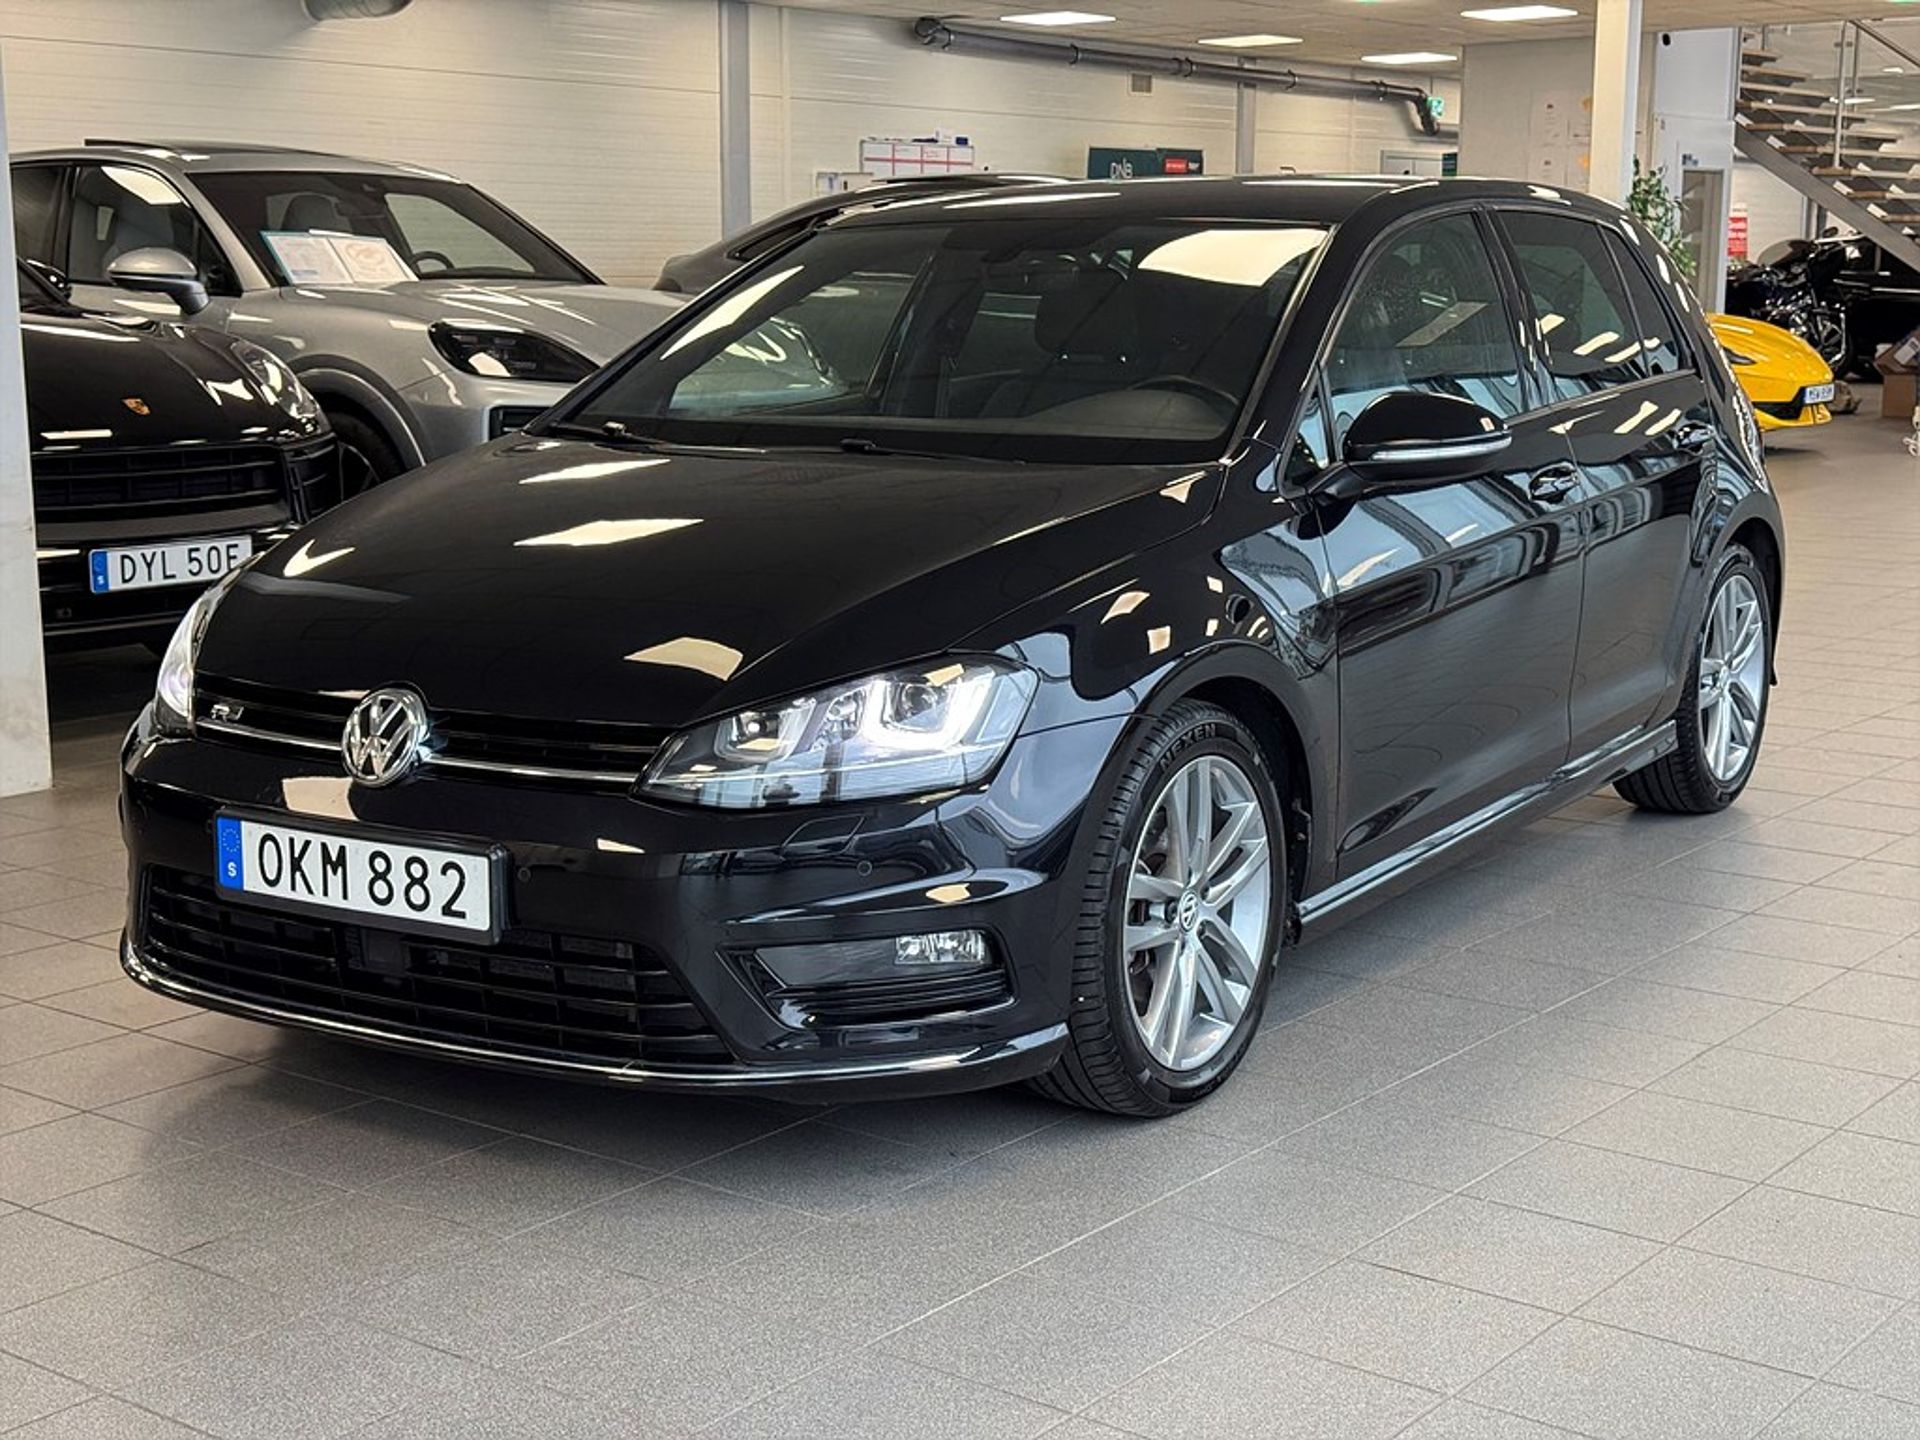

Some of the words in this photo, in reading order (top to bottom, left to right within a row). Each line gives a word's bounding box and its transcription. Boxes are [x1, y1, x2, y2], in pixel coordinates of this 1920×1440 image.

[120, 551, 176, 583] DYL
[1160, 723, 1216, 771] NEXEN
[227, 862, 237, 878] S
[258, 833, 349, 901] OKM
[367, 850, 467, 920] 882
